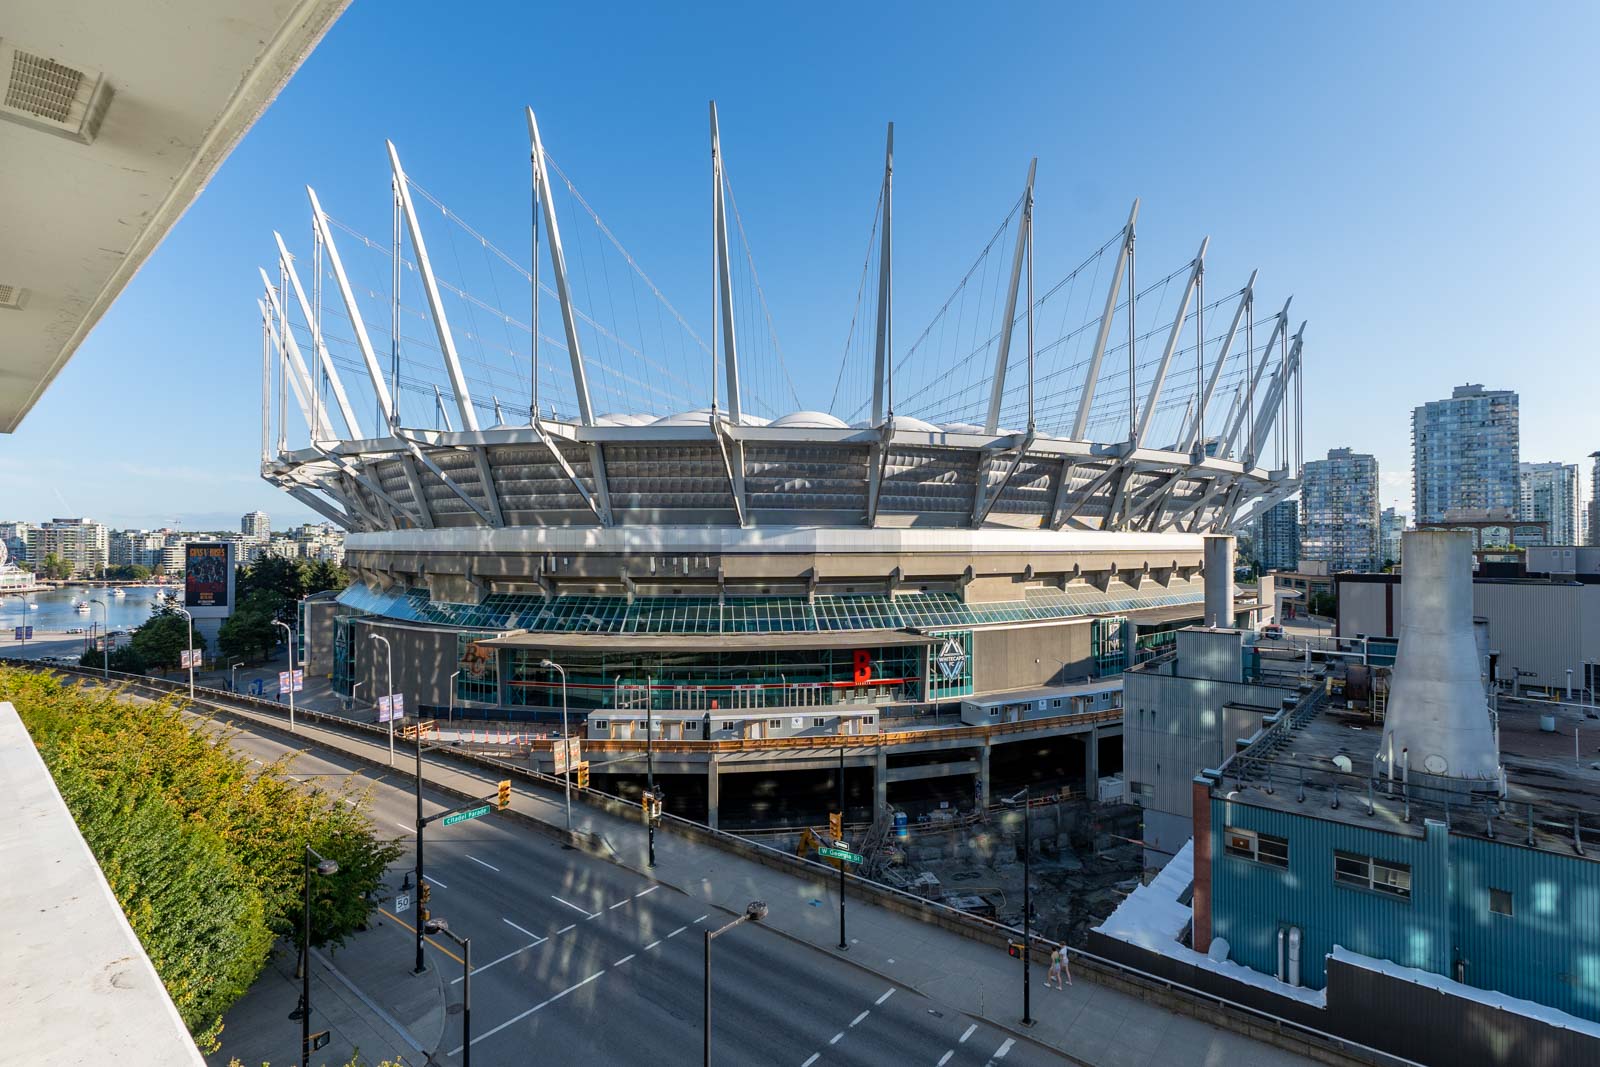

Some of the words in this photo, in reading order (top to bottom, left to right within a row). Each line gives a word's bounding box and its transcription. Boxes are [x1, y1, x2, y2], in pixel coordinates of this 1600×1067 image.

[854, 649, 871, 683] B
[446, 813, 467, 824] Citadel
[468, 808, 487, 818] Parade
[829, 850, 852, 860] Georgia
[397, 897, 409, 908] 50
